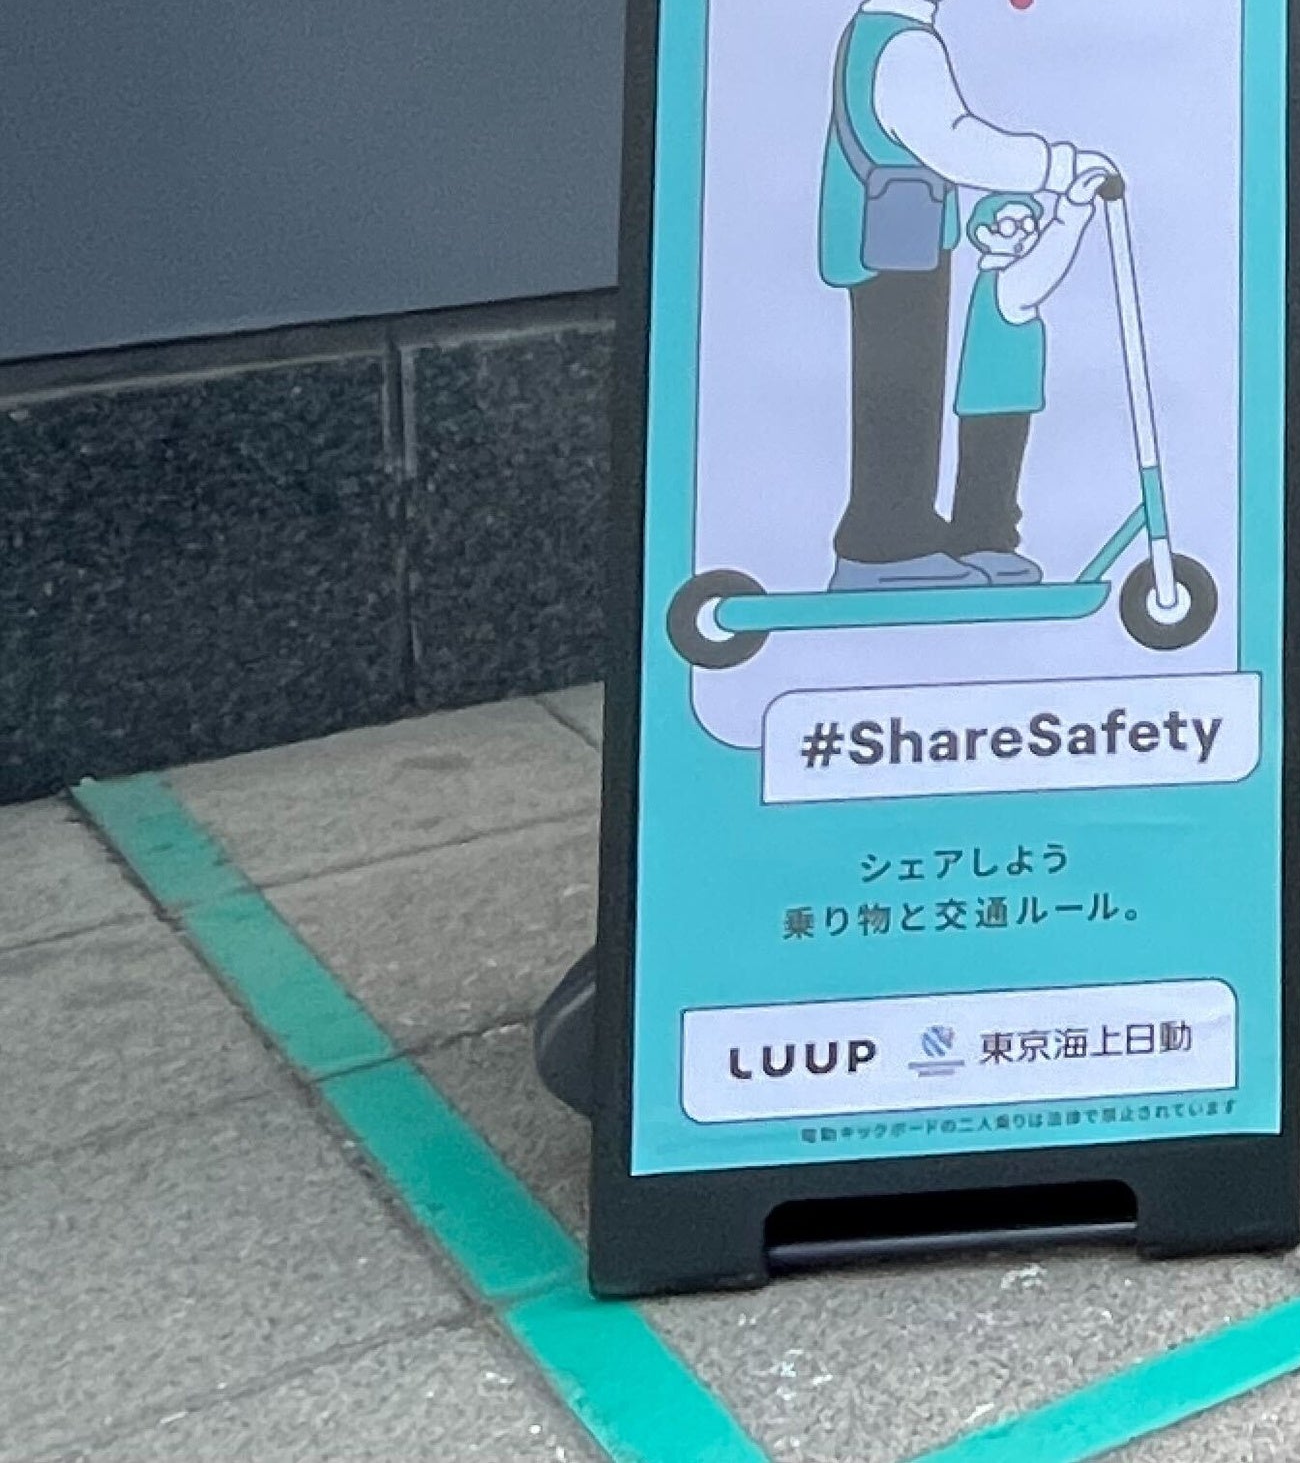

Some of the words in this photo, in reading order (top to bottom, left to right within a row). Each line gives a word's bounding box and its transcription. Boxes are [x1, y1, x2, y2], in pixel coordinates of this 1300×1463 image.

[799, 707, 1224, 769] #ShareSafety
[860, 843, 1068, 883] シェアしよう
[783, 892, 1139, 940] 乗り物と交通ルール。
[729, 1039, 878, 1081] LUUP
[978, 1019, 1194, 1066] 東京海上日動
